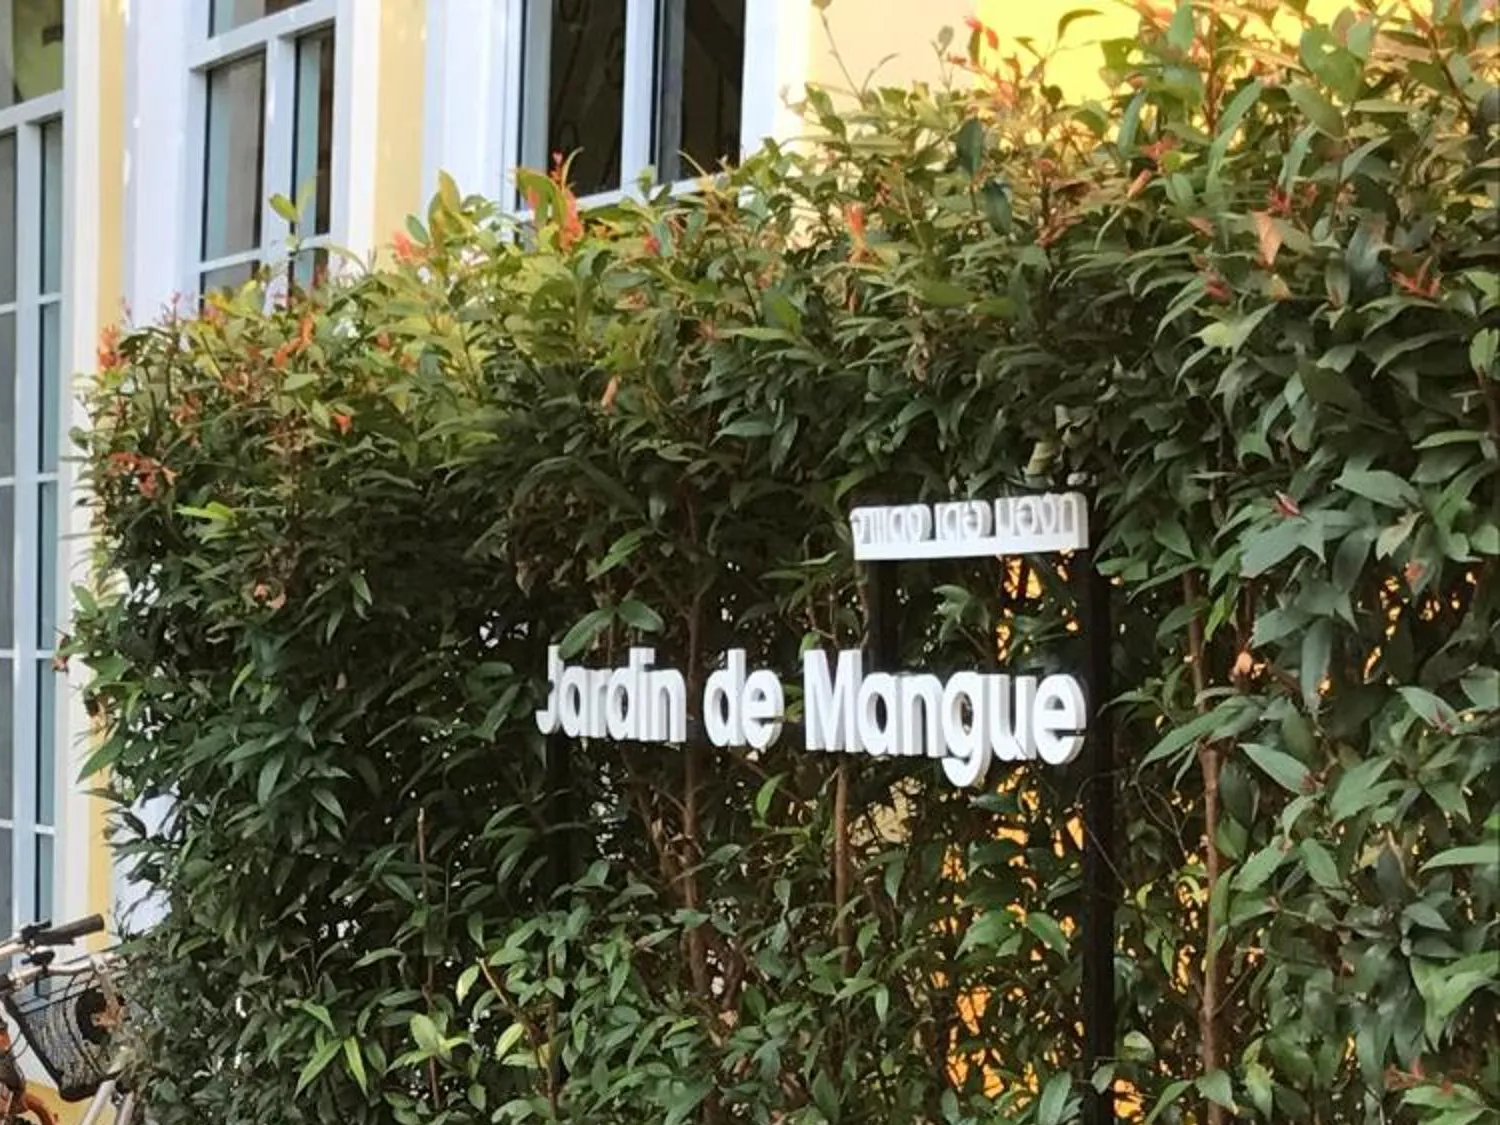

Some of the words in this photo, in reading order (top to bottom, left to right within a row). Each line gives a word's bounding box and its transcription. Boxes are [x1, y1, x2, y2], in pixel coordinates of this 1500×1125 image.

[536, 644, 687, 743] Jardin
[703, 647, 784, 749] de
[803, 647, 1087, 788] Mangue
